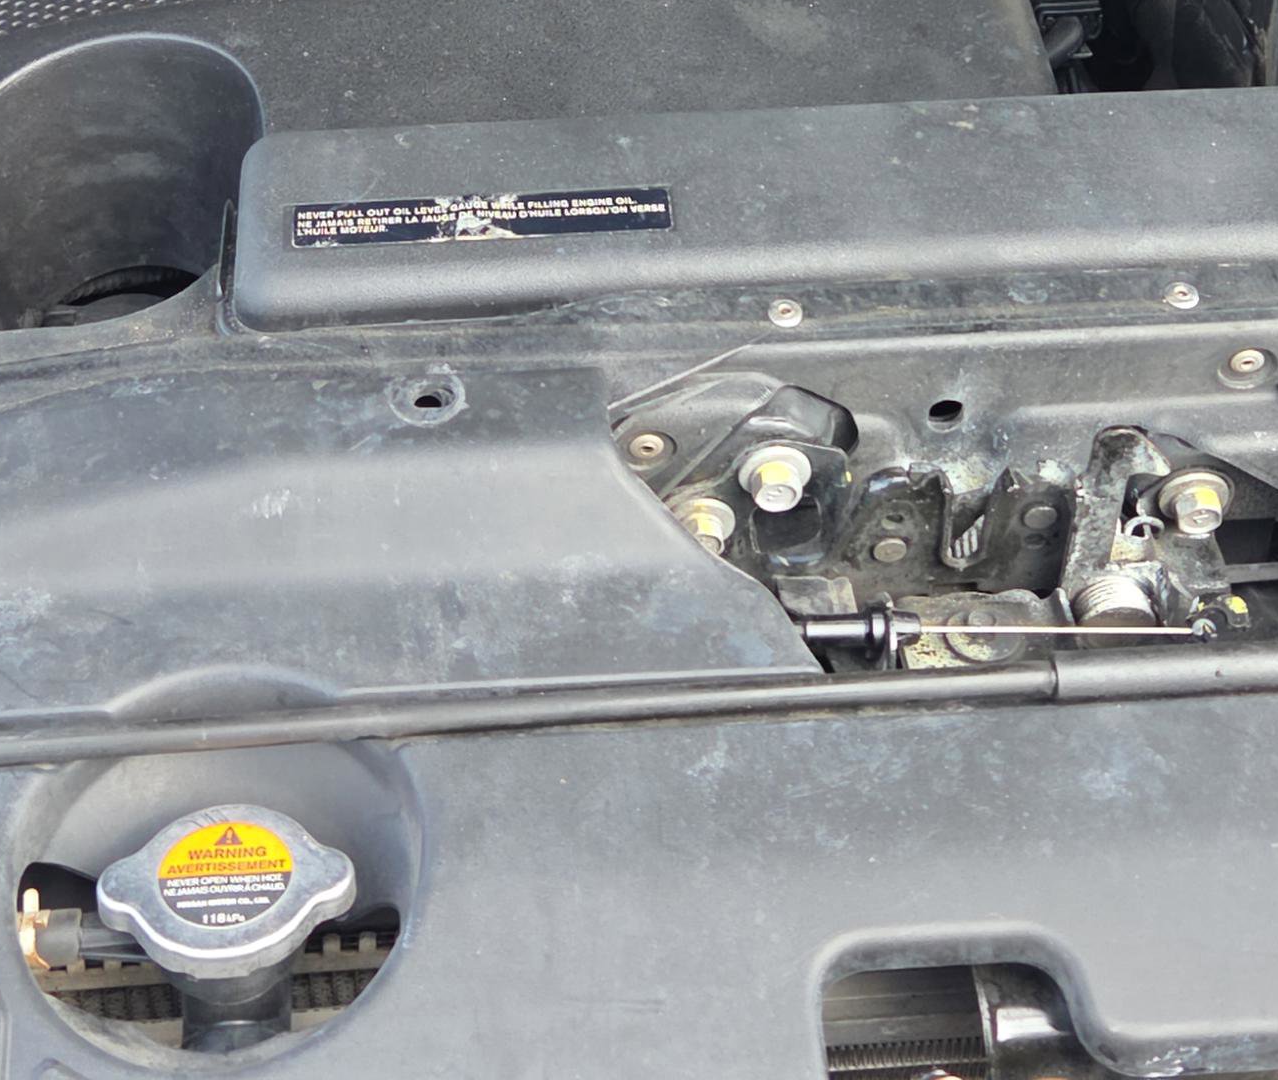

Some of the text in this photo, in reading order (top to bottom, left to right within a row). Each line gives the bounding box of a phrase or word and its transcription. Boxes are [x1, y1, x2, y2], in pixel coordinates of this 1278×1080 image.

[297, 211, 334, 220] NEVER
[337, 210, 364, 218] PULL
[367, 209, 389, 217] OUT
[393, 208, 411, 216] OIL
[415, 206, 448, 215] LEVEL
[450, 201, 488, 212] GAUGE
[528, 200, 569, 209] FILLING
[571, 198, 613, 207] ENGINE
[616, 196, 638, 205] OIL.
[297, 203, 666, 228] NE JAMAIS RETIRER LA JAUGE DE NIVEAU D'HUILE LORSQU'ON VERSE
[297, 225, 389, 236] L'HUILE MOTEUR.
[188, 846, 267, 860] WARNING
[167, 859, 286, 875] AVERTISSEMENT
[167, 877, 199, 887] NEVER
[201, 876, 228, 885] OPEN
[229, 875, 261, 884] WHEN
[163, 887, 176, 896] NE
[177, 885, 208, 895] JAMAIS
[209, 883, 244, 894] OUVRIR
